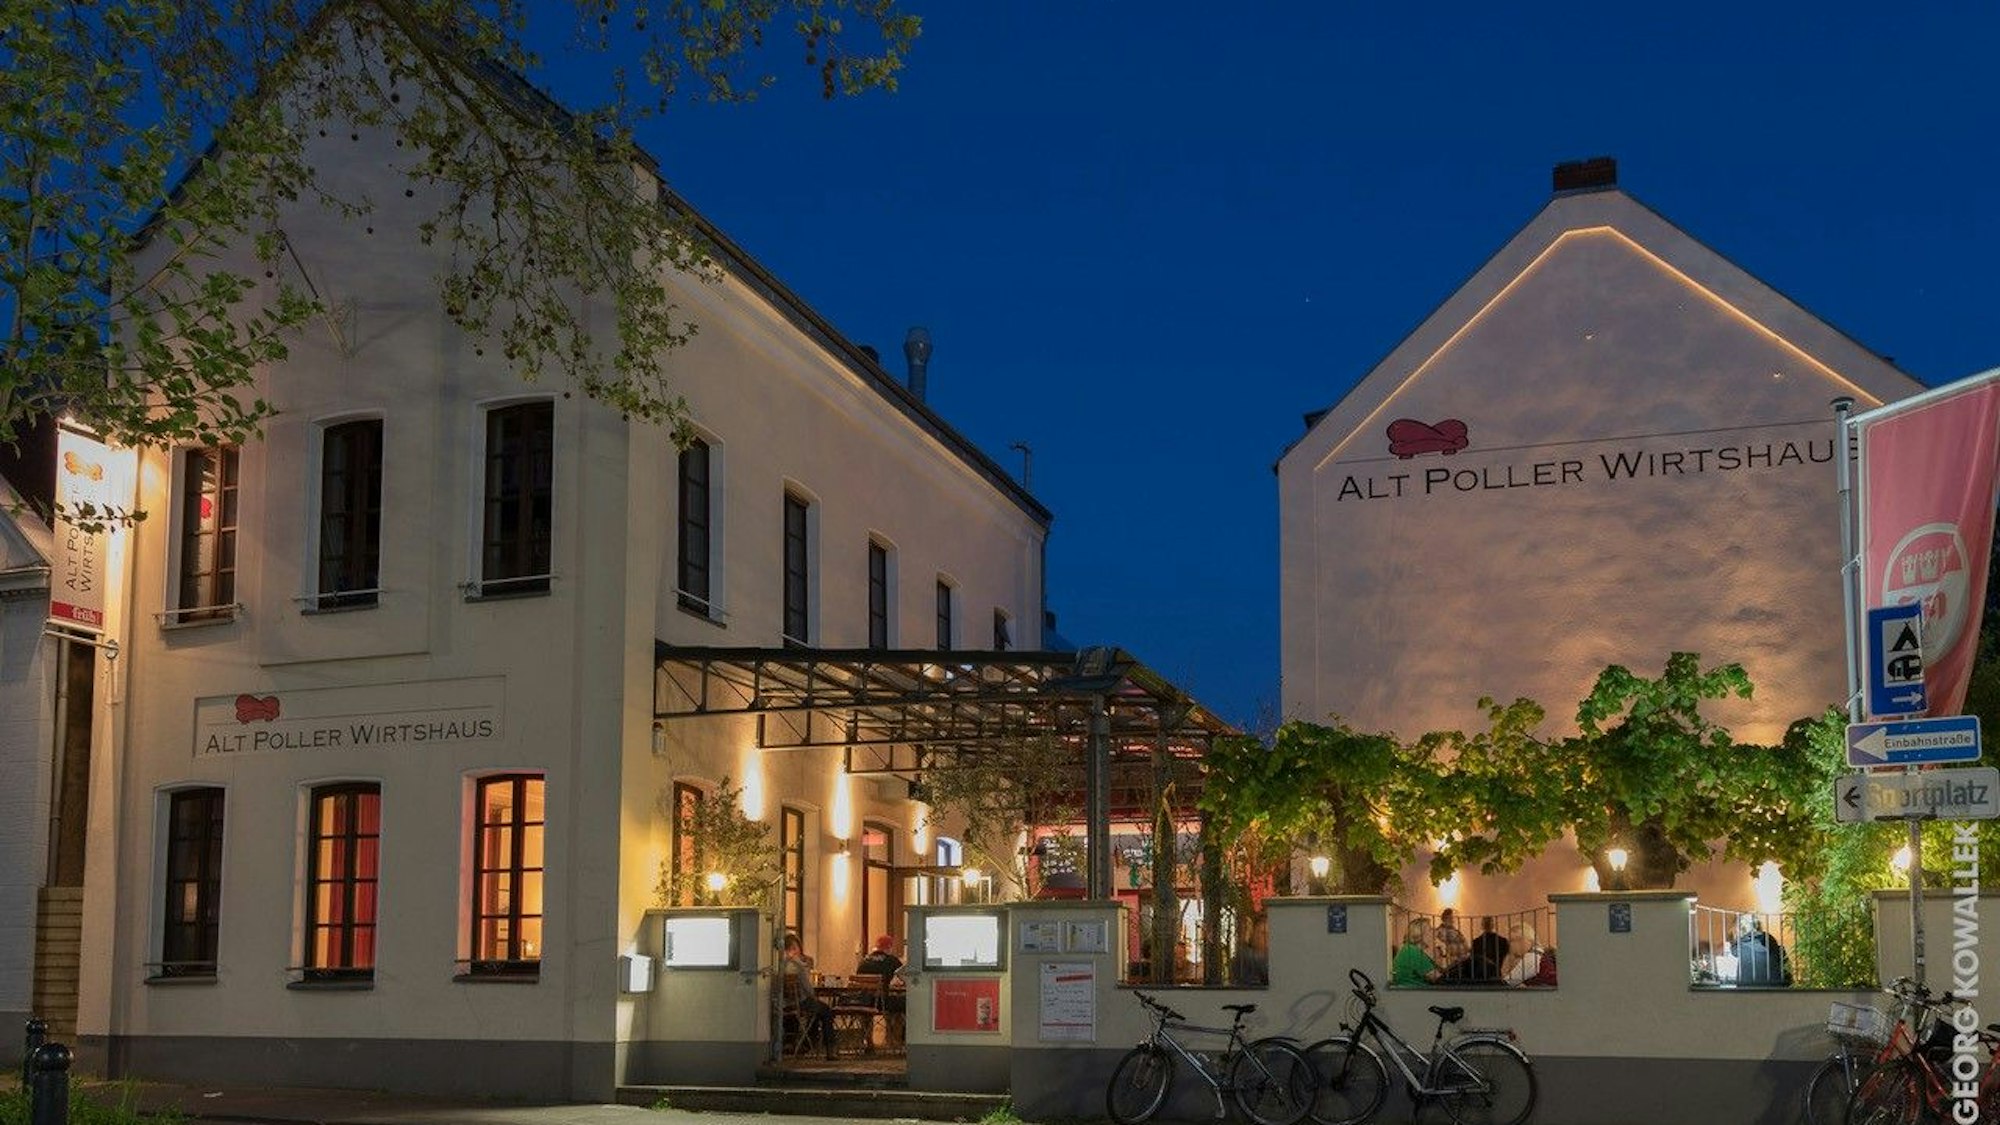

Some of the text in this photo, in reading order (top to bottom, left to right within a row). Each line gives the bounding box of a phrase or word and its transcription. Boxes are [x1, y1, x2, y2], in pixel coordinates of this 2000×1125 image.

[1337, 475, 1410, 501] ALT
[1425, 460, 1584, 494] POLLER
[65, 557, 79, 591] ALT
[205, 719, 494, 754] ALT POLLER WIRTSHAUS
[1883, 733, 1972, 749] Einbahnstraße
[1866, 779, 1989, 813] Sportplatz
